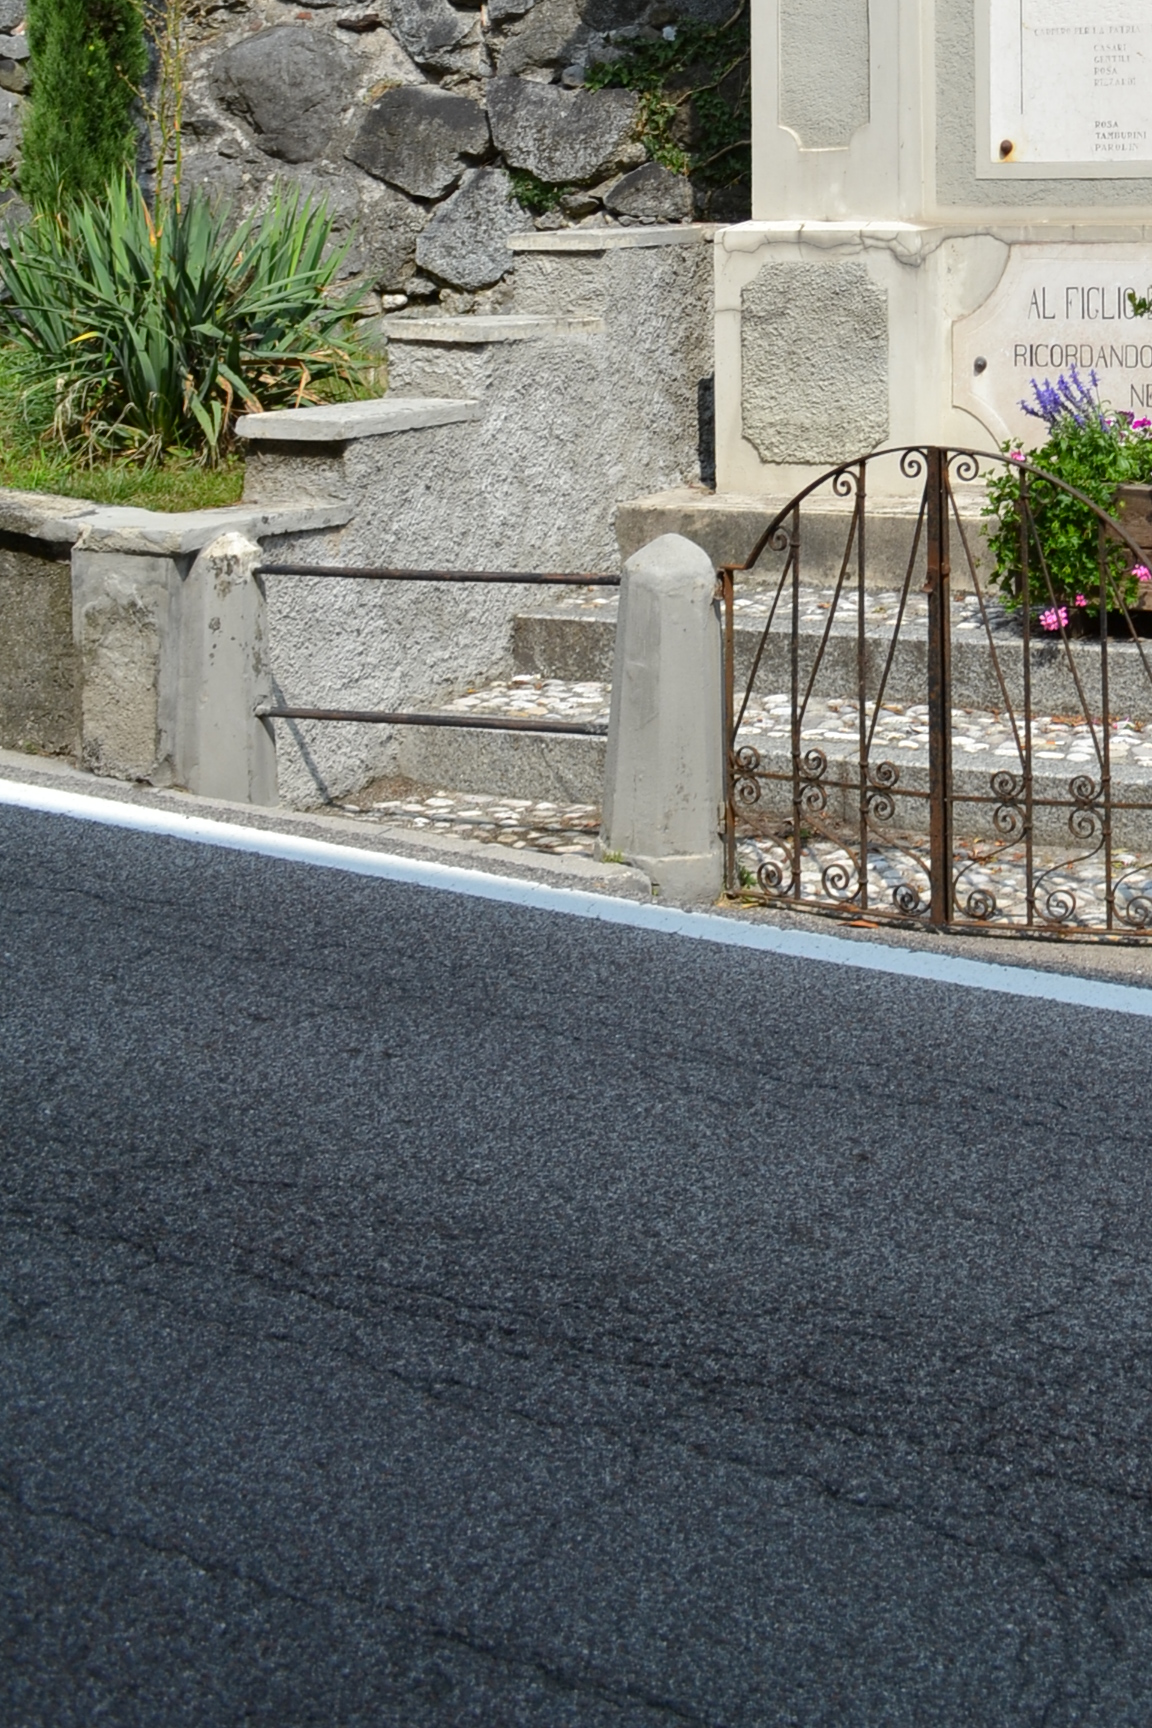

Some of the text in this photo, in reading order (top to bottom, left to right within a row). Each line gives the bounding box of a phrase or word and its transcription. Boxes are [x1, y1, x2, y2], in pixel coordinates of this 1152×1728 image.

[1109, 26, 1141, 34] PATRIA
[1094, 67, 1118, 75] ROSA
[1095, 131, 1147, 139] TAMBURINI
[1028, 286, 1056, 320] AL
[1066, 286, 1136, 320] FIGLIO
